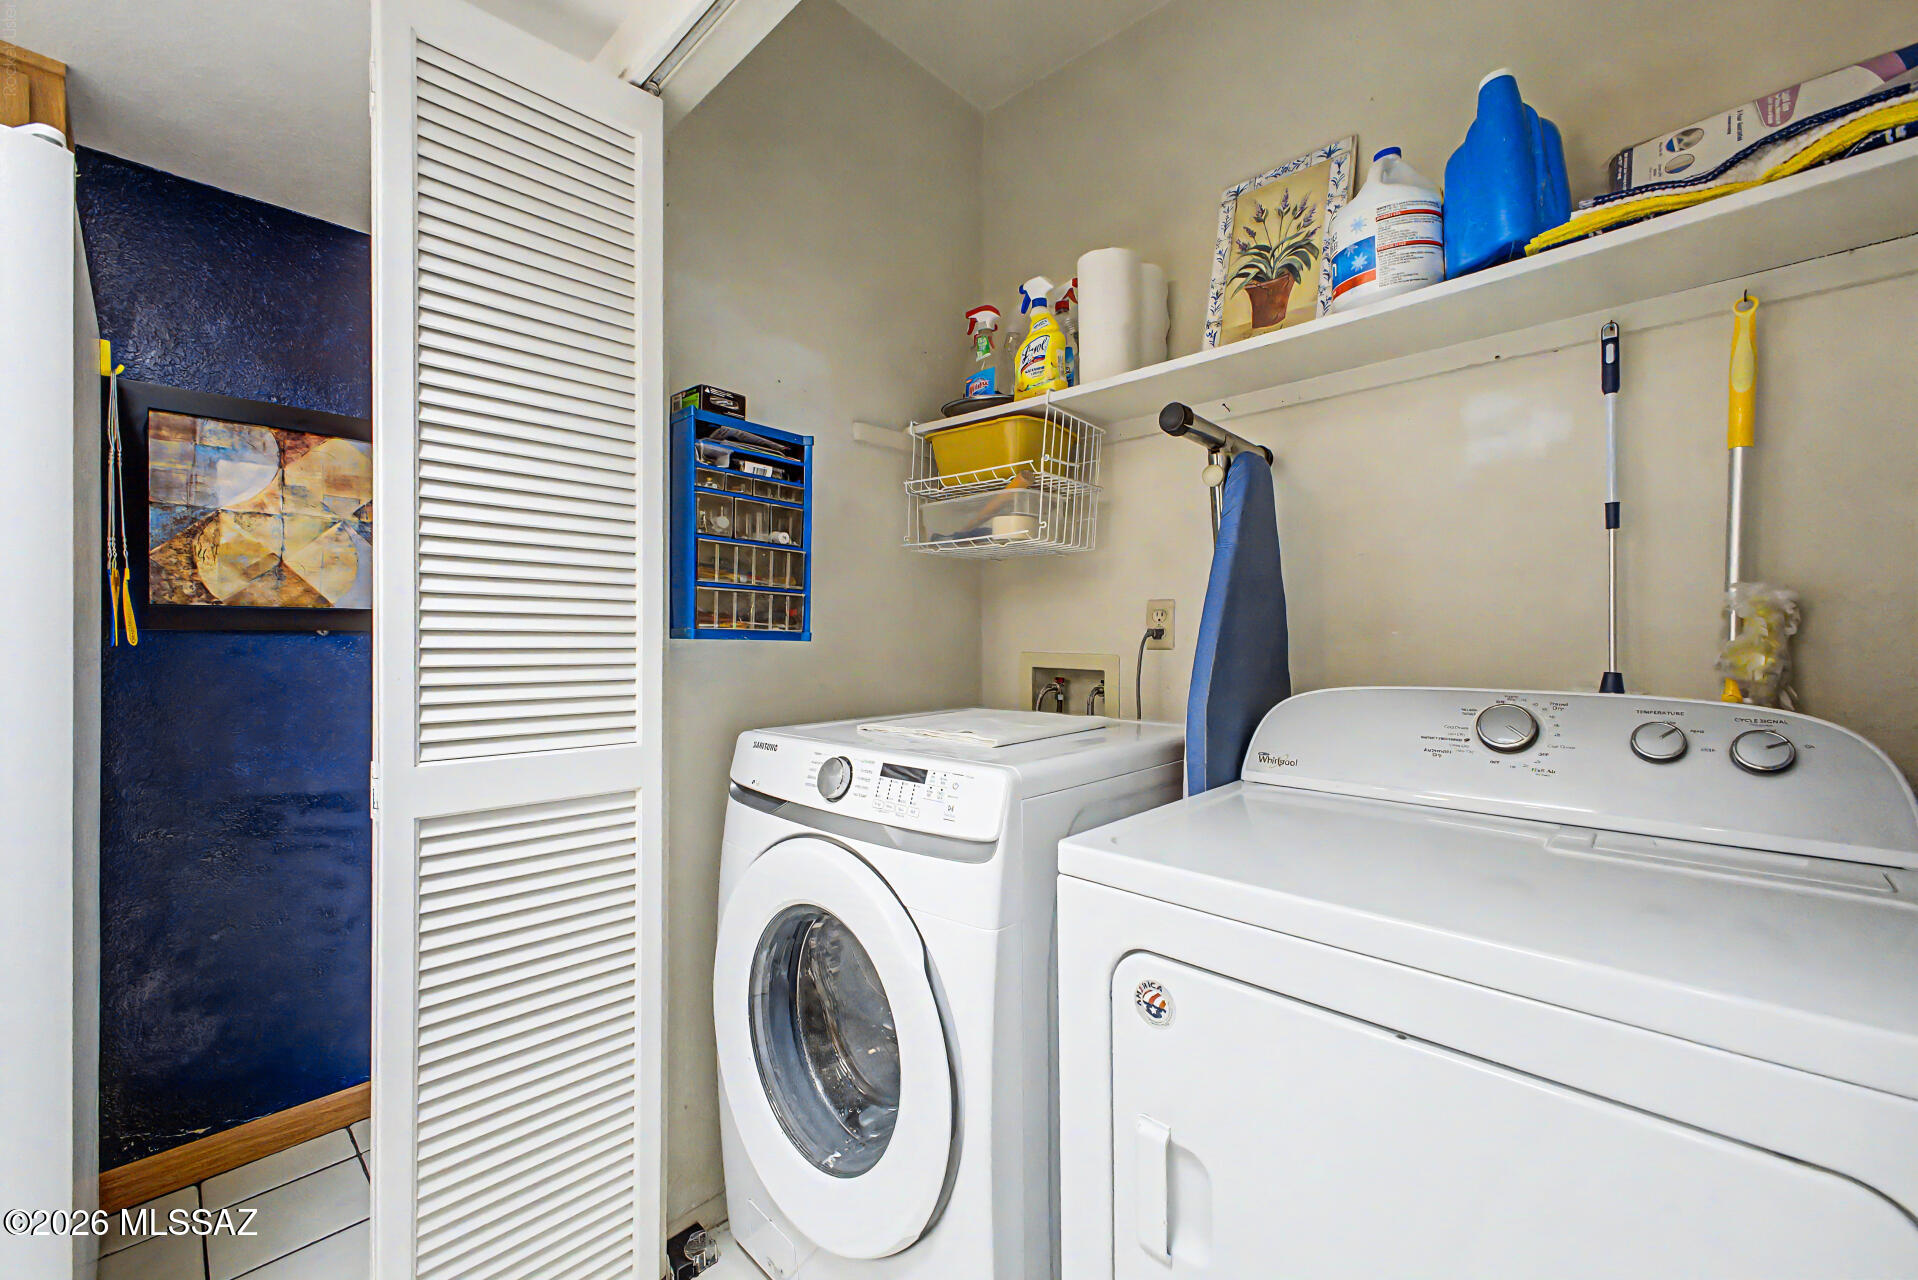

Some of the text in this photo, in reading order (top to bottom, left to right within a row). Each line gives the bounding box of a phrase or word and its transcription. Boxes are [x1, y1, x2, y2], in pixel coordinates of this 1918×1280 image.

[1635, 709, 1685, 717] TEMPERATURE
[752, 740, 779, 752] SAMSUNG
[1258, 754, 1298, 768] Whirlpool
